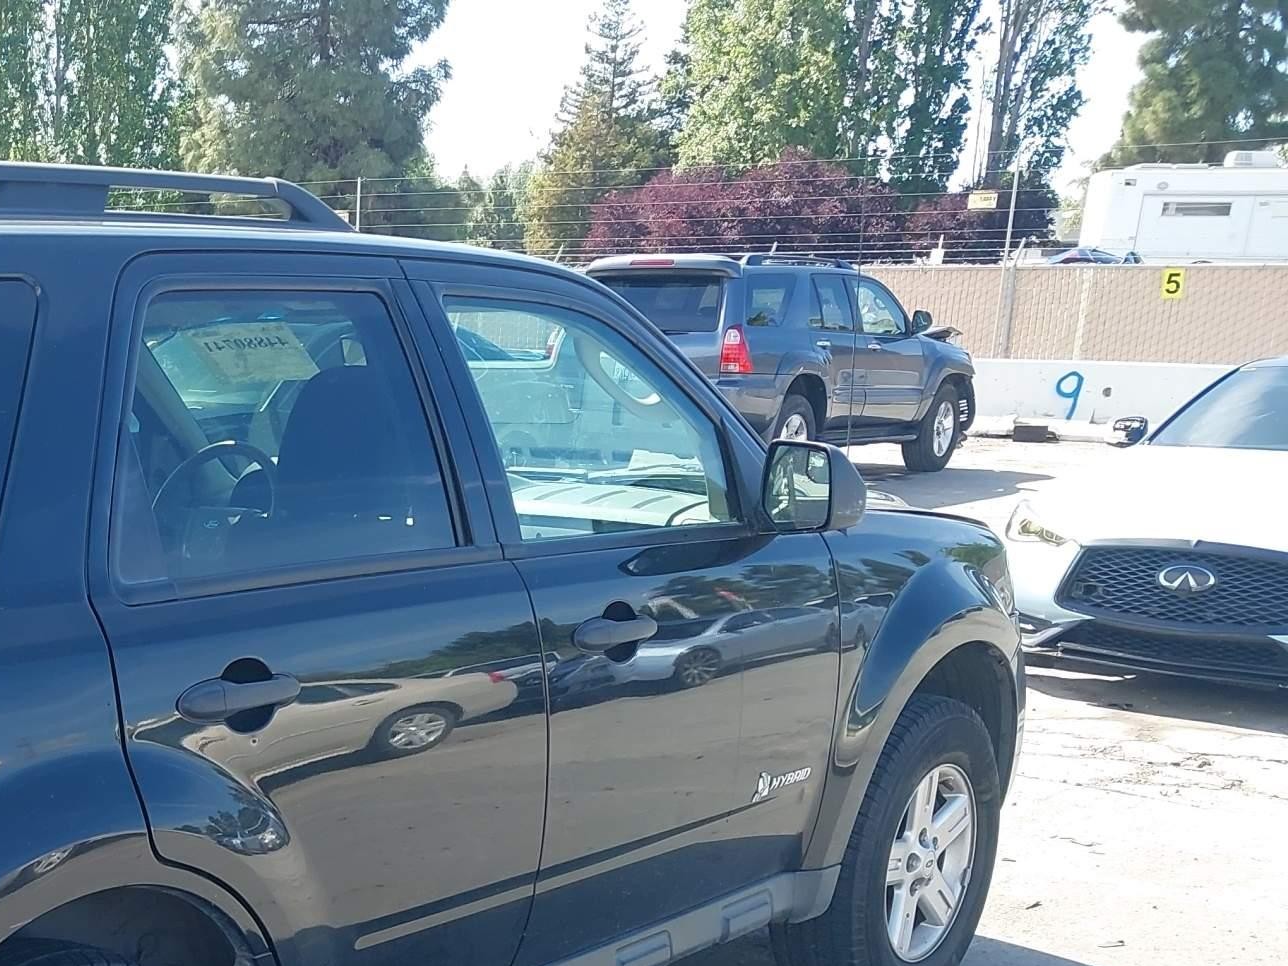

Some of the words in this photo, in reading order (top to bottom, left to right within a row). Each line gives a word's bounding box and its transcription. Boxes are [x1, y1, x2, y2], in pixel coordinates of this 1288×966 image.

[1165, 272, 1181, 294] 5
[1055, 370, 1085, 421] 9
[770, 767, 812, 791] HYBRID
